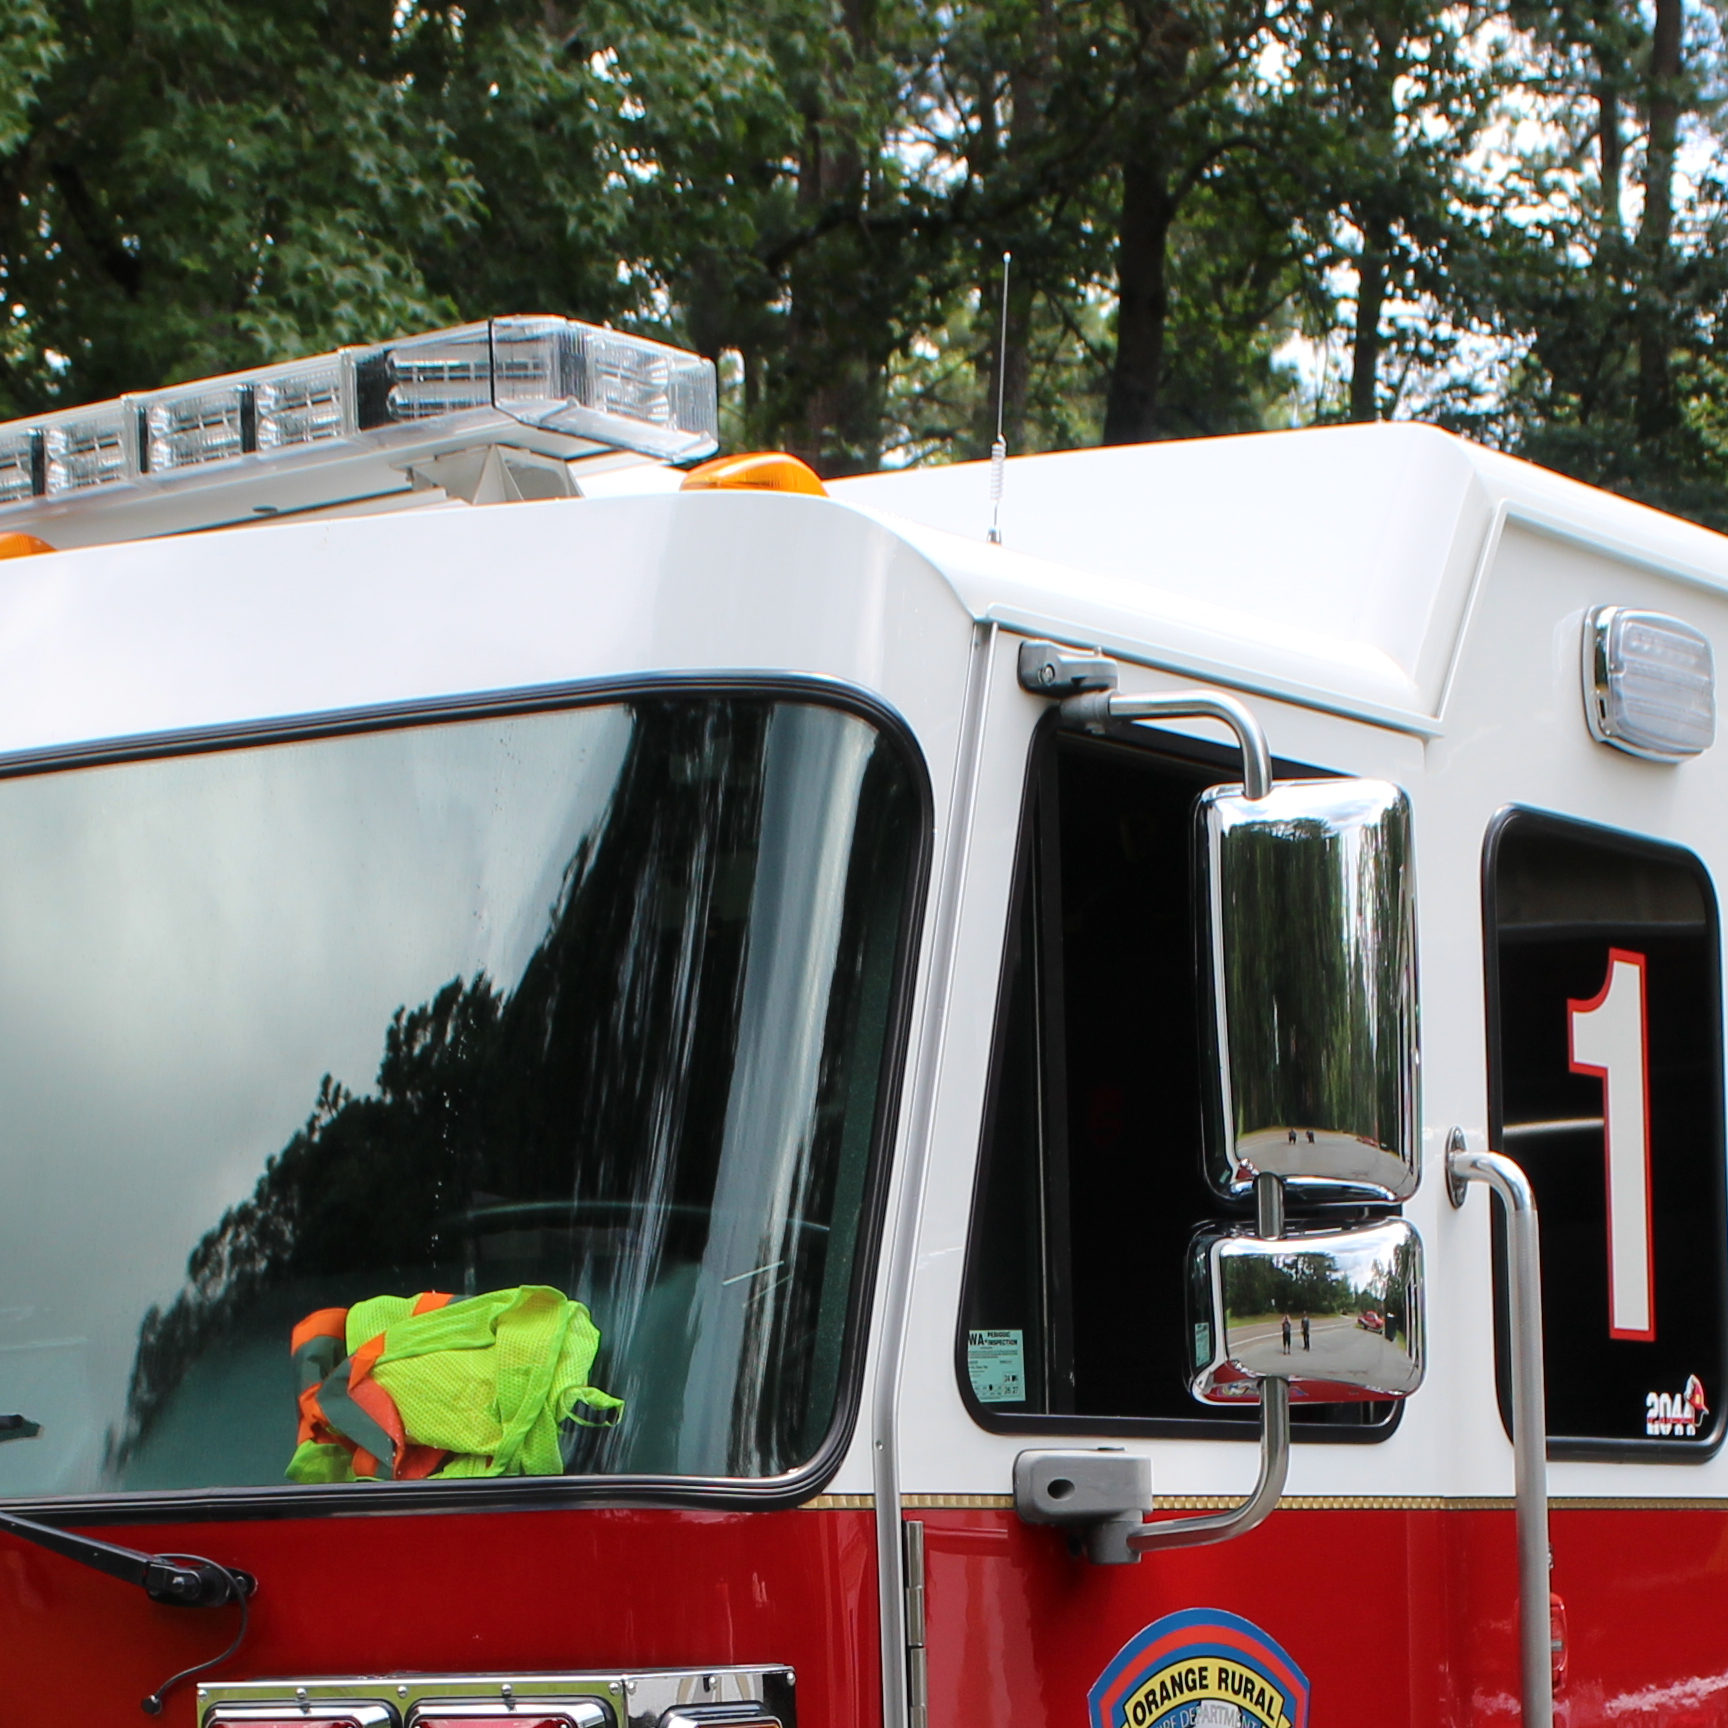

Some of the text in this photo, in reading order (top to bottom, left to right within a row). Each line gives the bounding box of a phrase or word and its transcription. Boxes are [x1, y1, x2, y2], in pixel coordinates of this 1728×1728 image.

[1567, 946, 1656, 1342] 1
[1133, 1666, 1275, 1727] ORANGE RURAL
